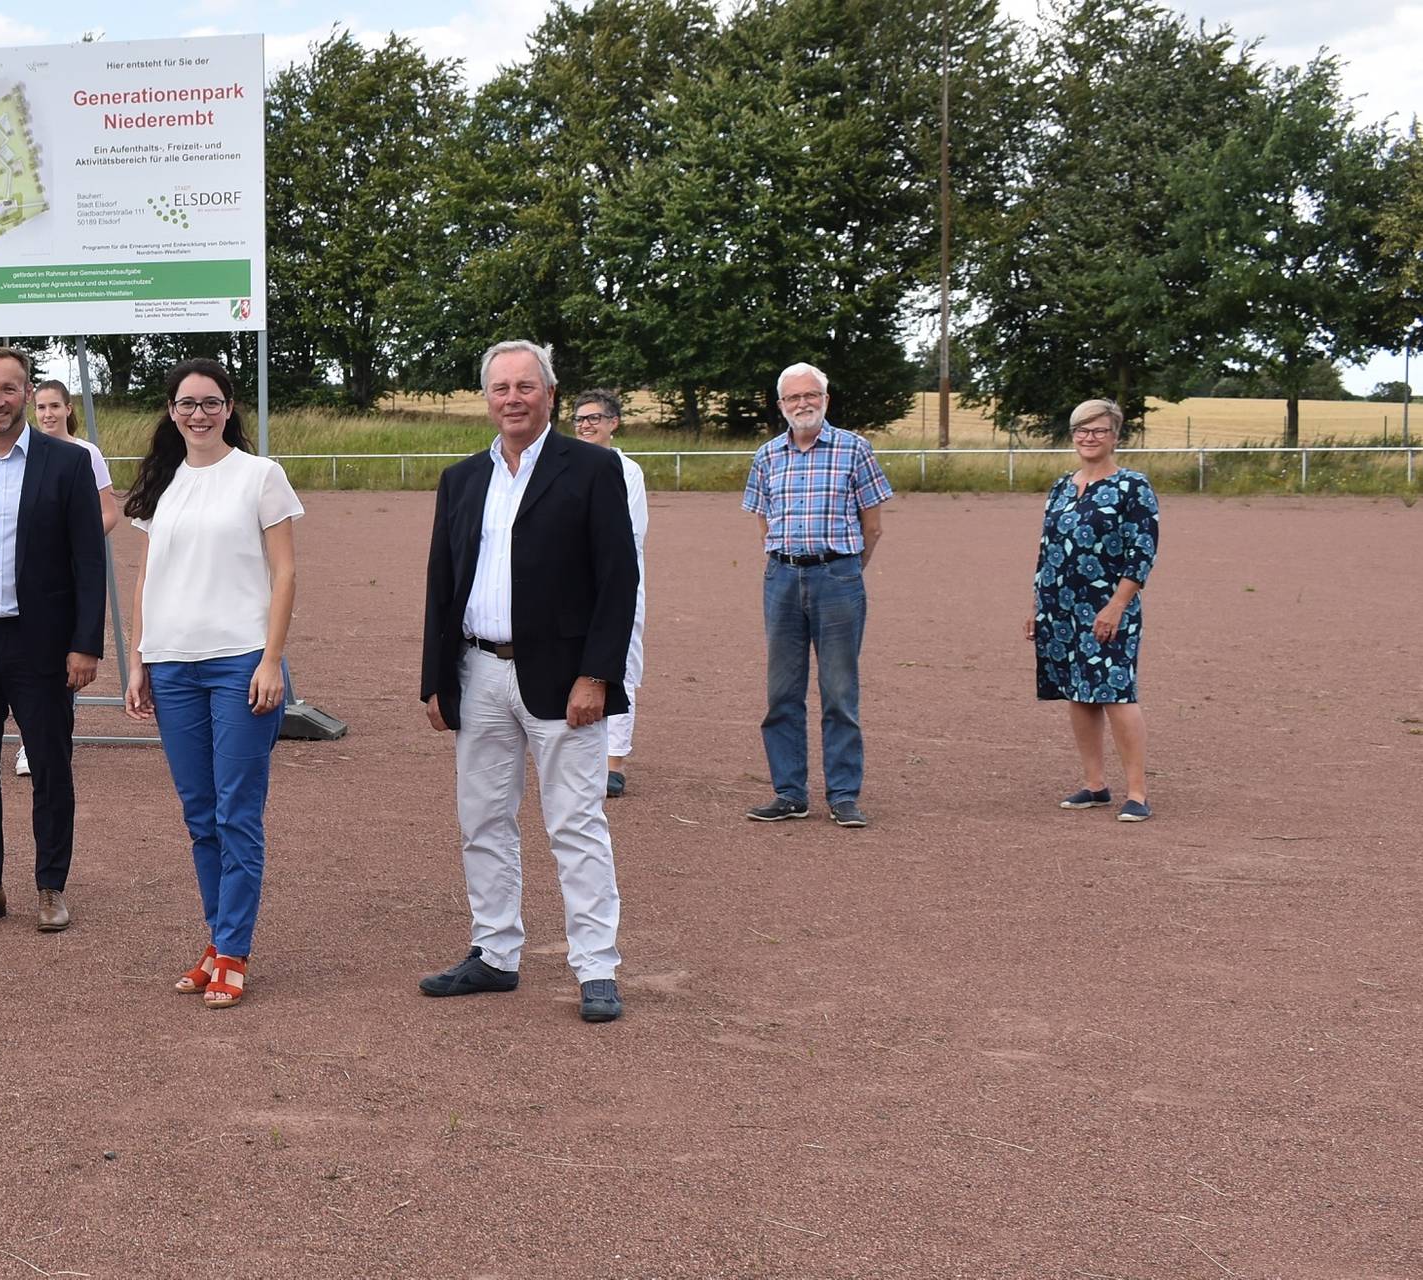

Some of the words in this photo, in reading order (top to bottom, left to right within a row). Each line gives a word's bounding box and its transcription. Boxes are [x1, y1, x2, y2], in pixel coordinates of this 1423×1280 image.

[107, 61, 124, 69] Hier
[127, 59, 162, 68] entsteht
[164, 58, 176, 67] für
[179, 57, 192, 66] Sie
[195, 57, 209, 65] der
[73, 82, 244, 106] Generationenpark
[104, 110, 214, 130] Niederembt
[94, 146, 108, 154] Ein
[110, 144, 164, 154] Aufenthalts-,
[167, 142, 202, 151] Freizeit-
[204, 142, 222, 150] und
[75, 156, 147, 166] Aktivitätsbereich
[150, 154, 162, 163] für
[164, 154, 180, 162] alle
[182, 152, 241, 162] Generationen
[174, 191, 242, 206] ELSDORF
